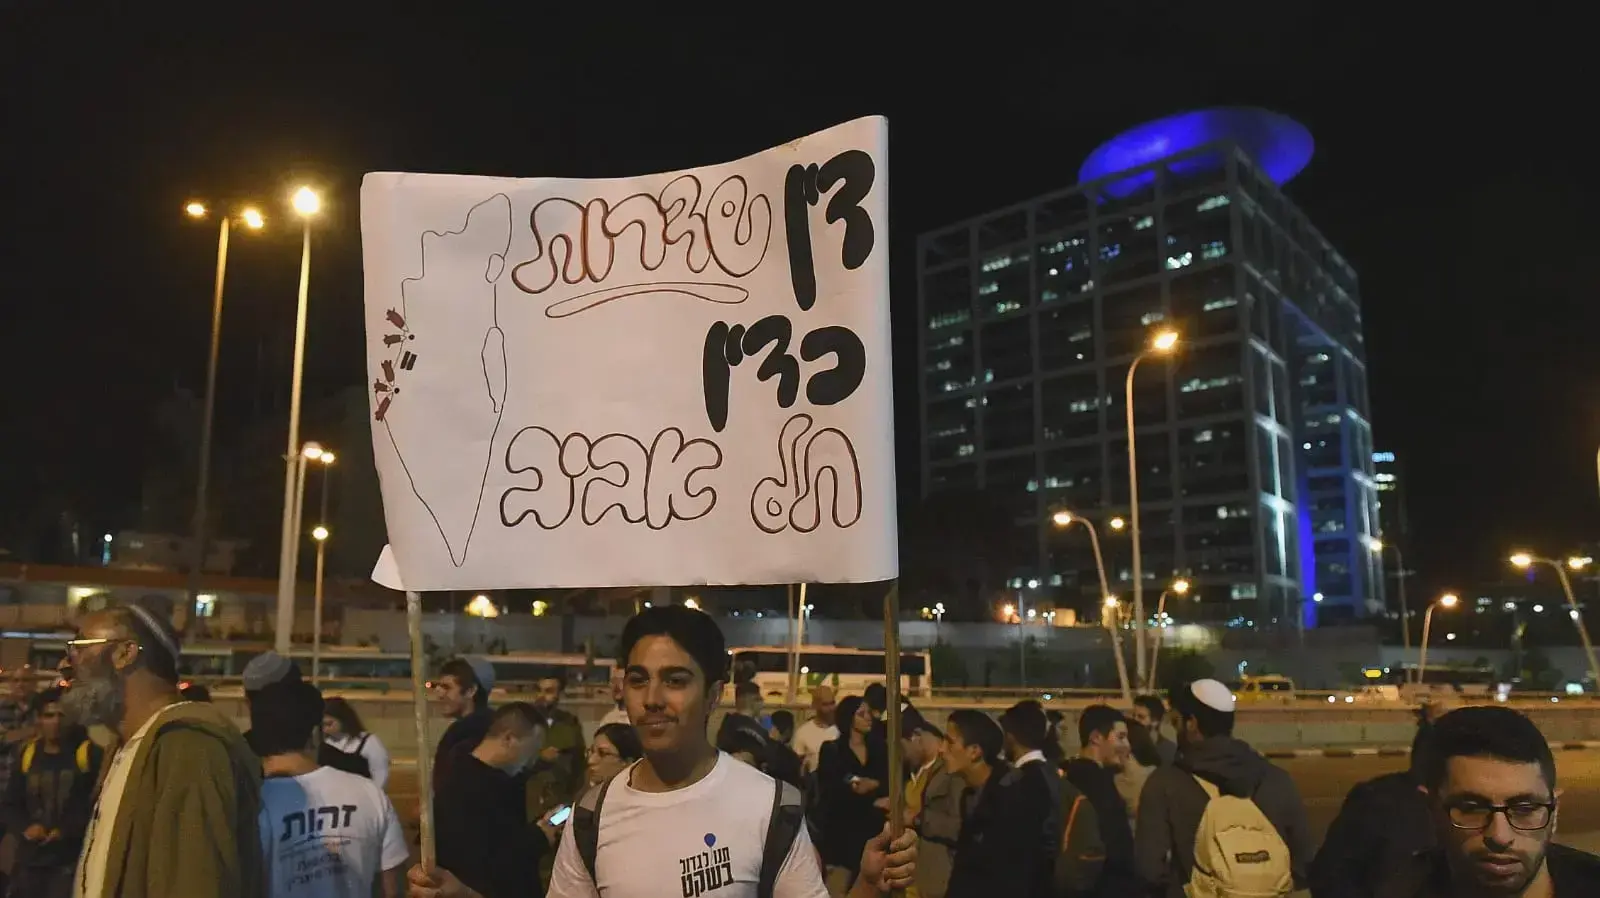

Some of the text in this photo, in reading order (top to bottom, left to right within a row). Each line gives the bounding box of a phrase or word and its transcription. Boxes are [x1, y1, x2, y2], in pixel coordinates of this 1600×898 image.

[511, 149, 876, 311] דין שדרות
[703, 314, 867, 432] כדין
[500, 412, 863, 533] תל אביב
[280, 804, 358, 842] זהות
[679, 846, 730, 875] תנו לגדול
[681, 862, 734, 898] בשקט
